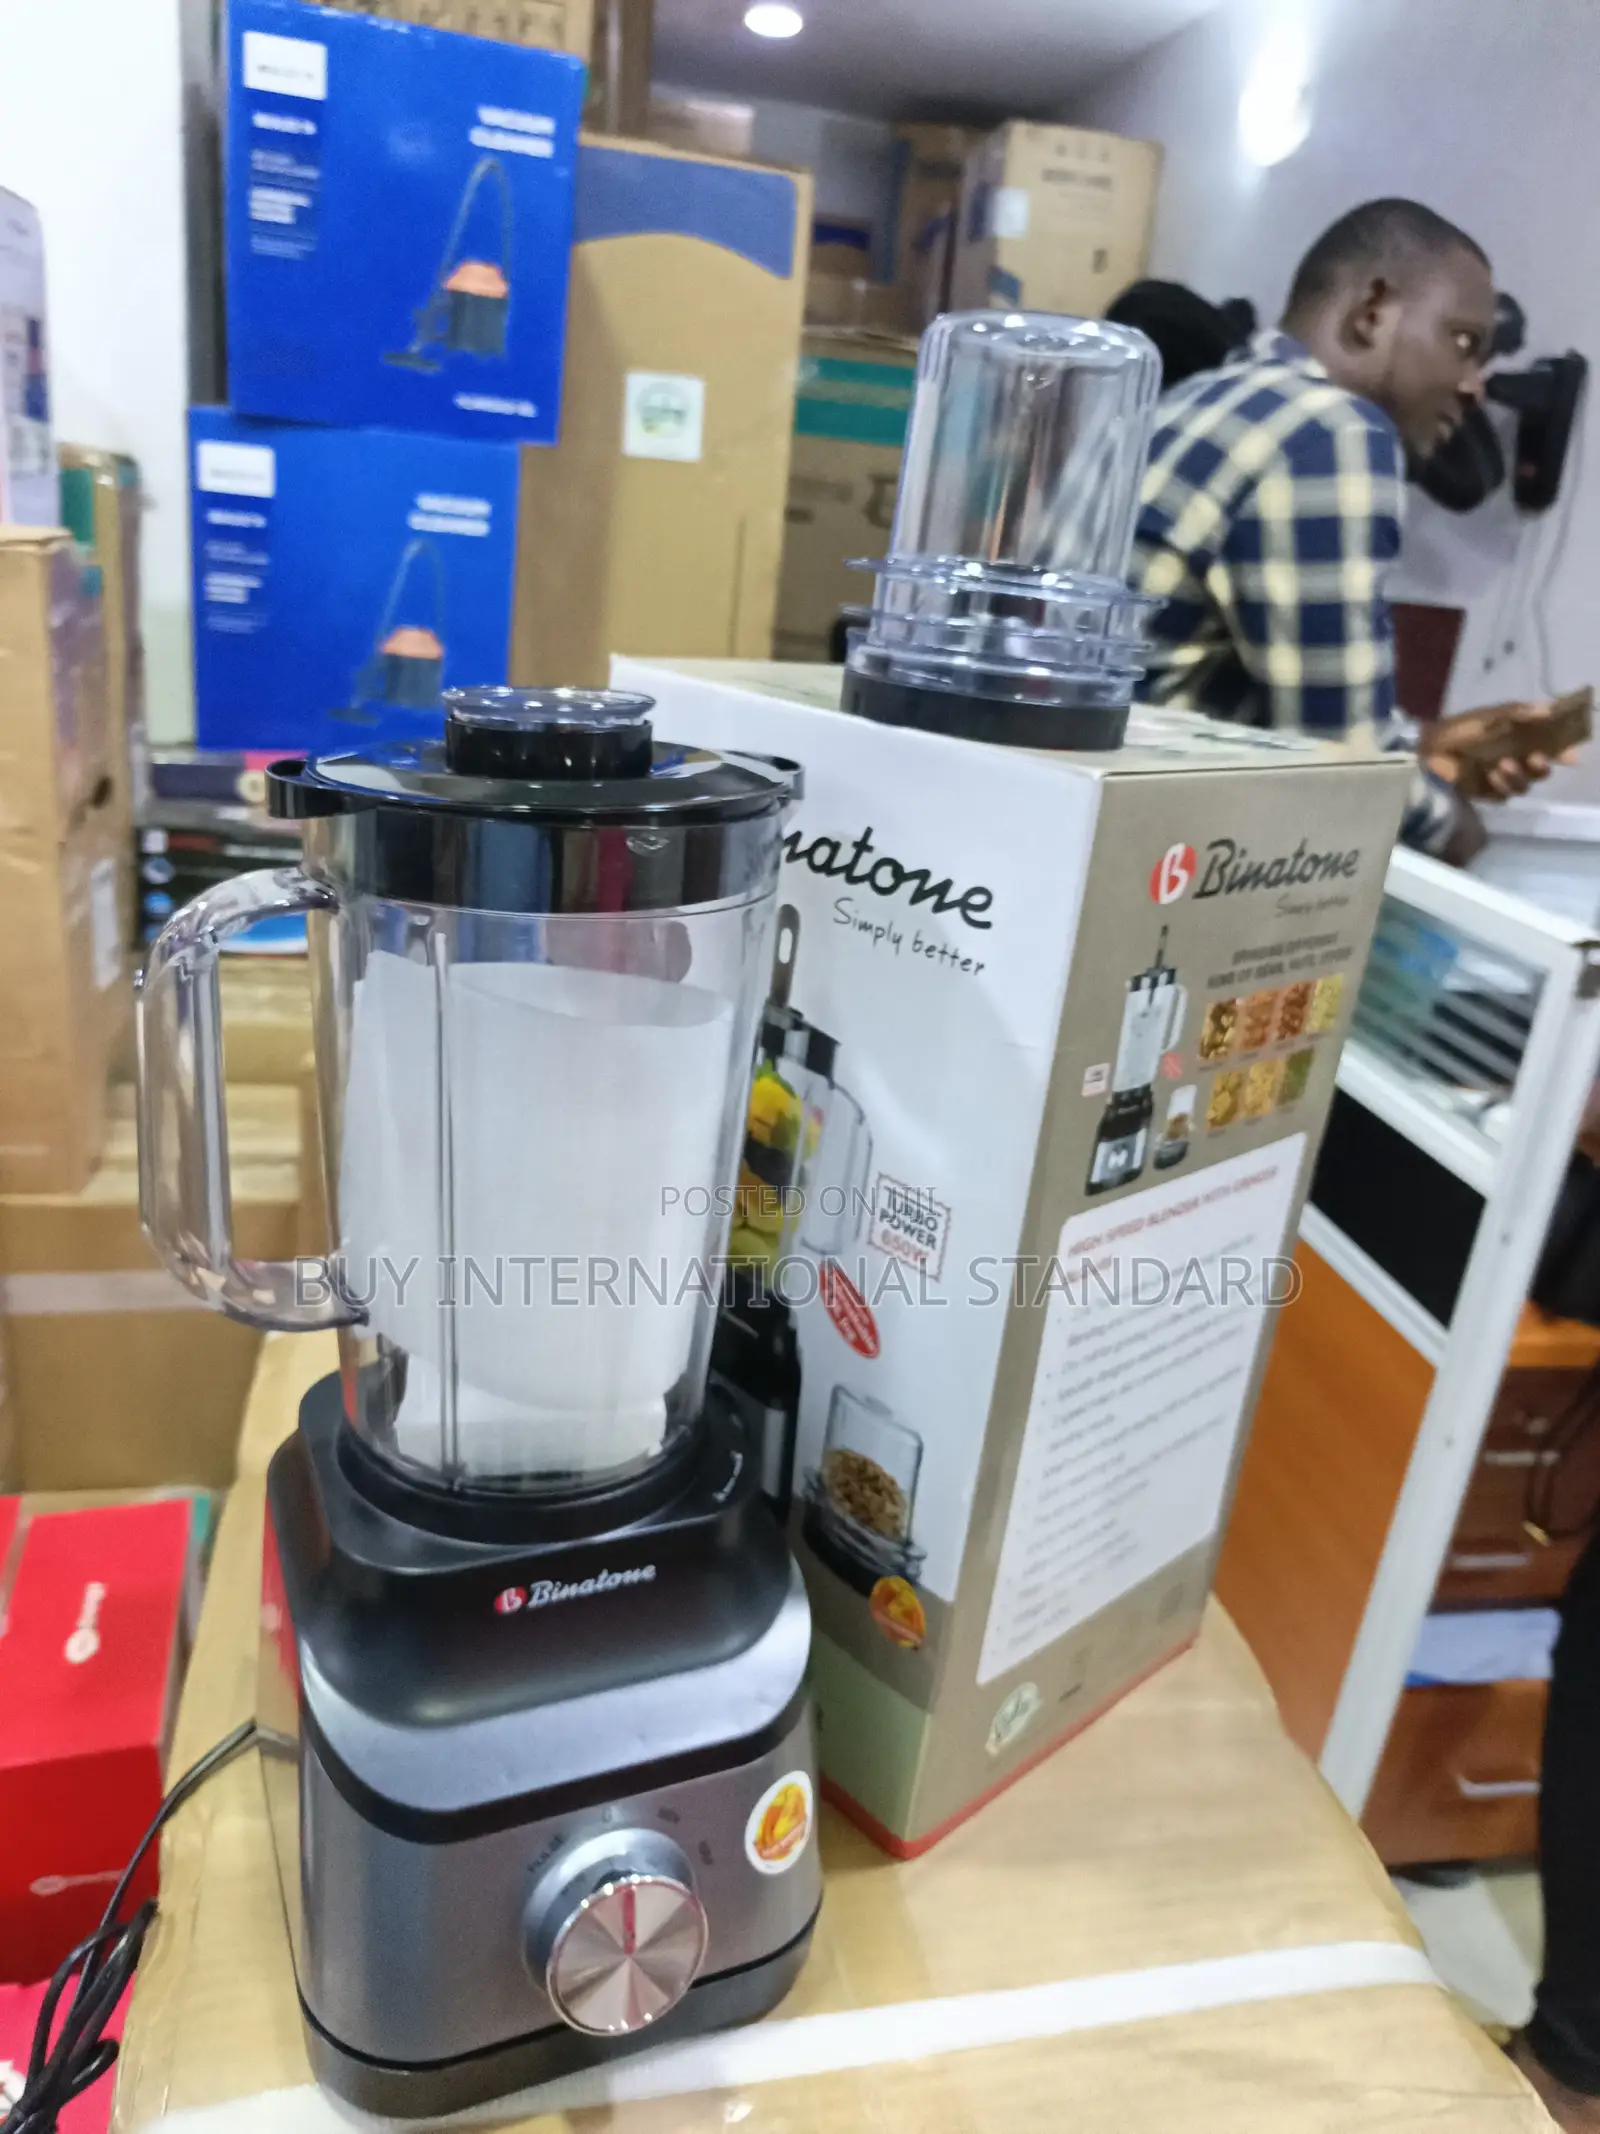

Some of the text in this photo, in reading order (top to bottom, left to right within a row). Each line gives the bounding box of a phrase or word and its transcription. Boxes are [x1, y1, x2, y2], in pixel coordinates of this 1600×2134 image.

[1192, 837, 1360, 900] Binatone
[832, 897, 986, 976] Simply better
[879, 1207, 937, 1251] POWER
[527, 1564, 656, 1610] Binatone
